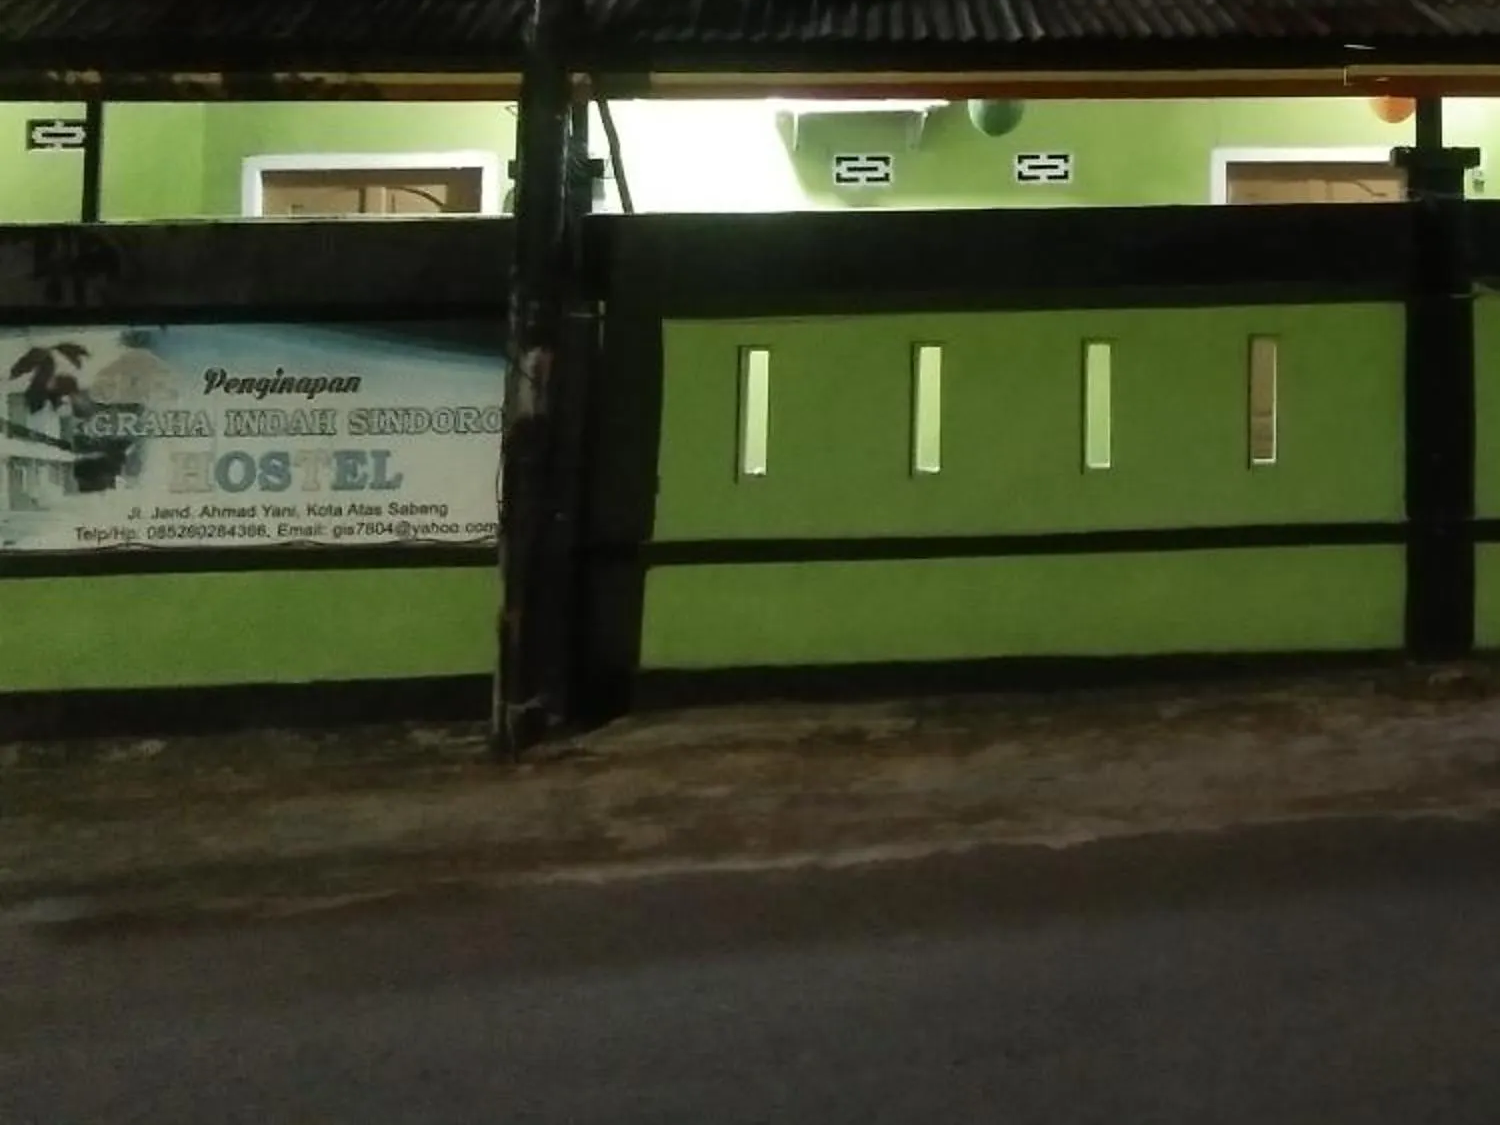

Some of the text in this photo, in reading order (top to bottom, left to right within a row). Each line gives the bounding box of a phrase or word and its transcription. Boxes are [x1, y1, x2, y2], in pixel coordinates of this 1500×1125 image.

[203, 367, 363, 400] Penginapan
[88, 407, 503, 438] GRAHA INDAH SINDORO
[169, 449, 404, 494] HOSTEL
[199, 505, 257, 518] Ahmad
[307, 503, 343, 517] Kota
[347, 503, 383, 517] Atas
